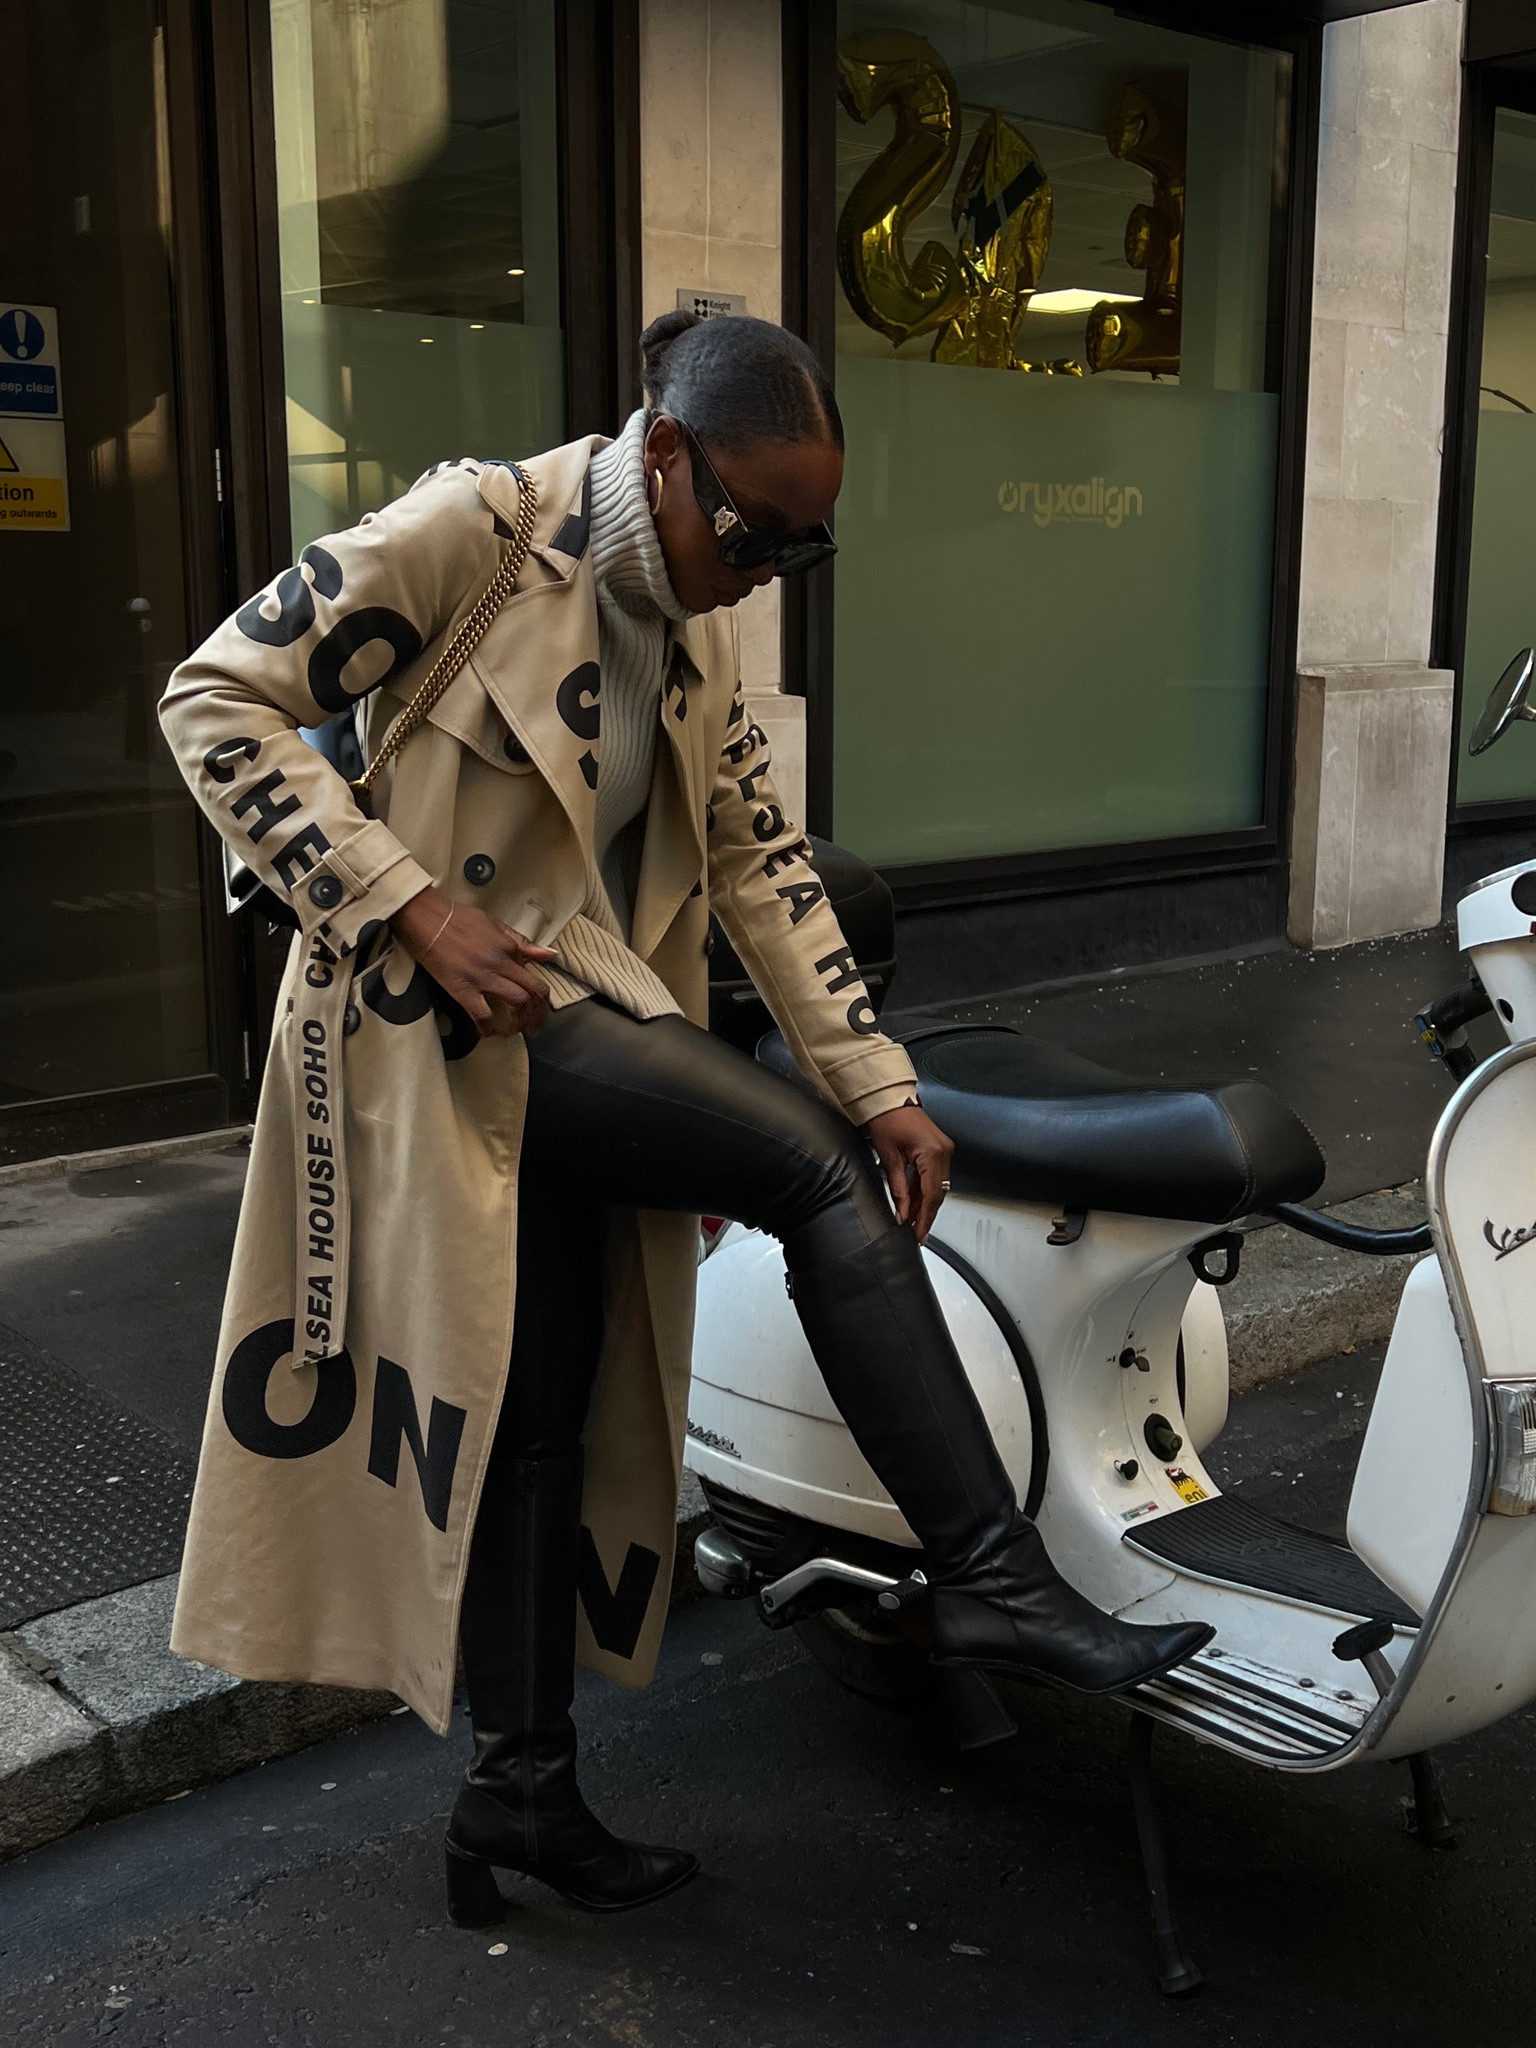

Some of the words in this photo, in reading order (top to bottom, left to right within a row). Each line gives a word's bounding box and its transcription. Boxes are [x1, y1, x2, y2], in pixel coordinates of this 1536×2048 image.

[26, 382, 55, 394] clear
[10, 508, 57, 518] outwards
[999, 477, 1143, 528] oryxalign
[302, 1019, 331, 1124] SOHO
[307, 1133, 335, 1262] HOUSE
[1184, 1485, 1209, 1504] eni
